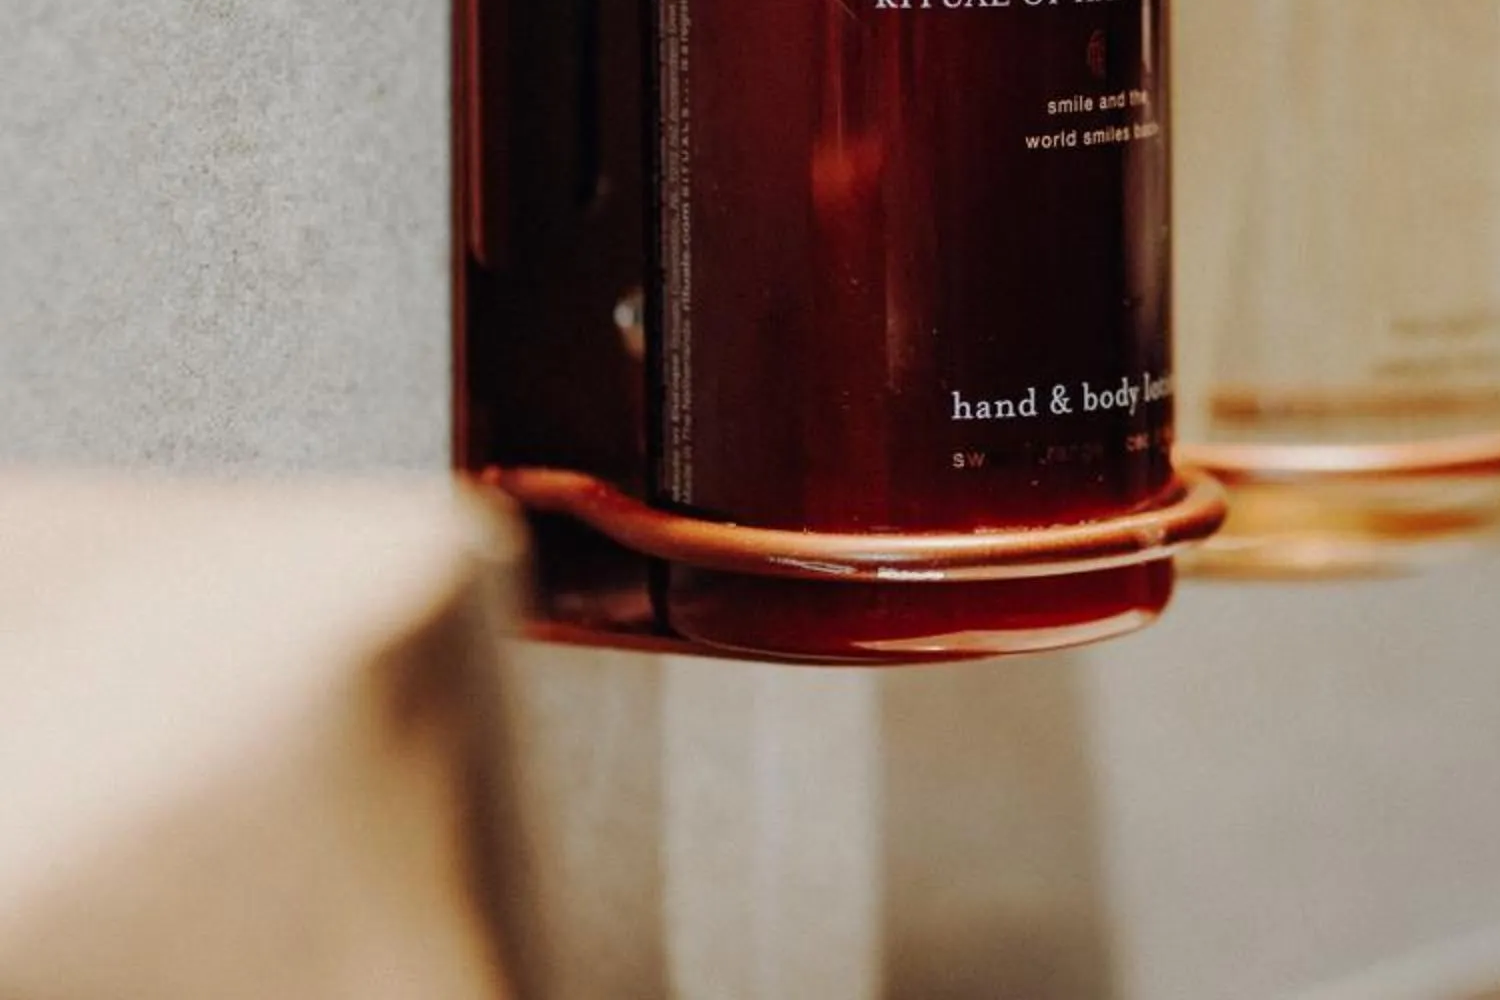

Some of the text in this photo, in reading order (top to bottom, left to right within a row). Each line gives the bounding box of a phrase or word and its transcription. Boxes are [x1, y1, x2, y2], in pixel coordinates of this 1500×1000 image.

[1047, 95, 1093, 115] smile
[1099, 91, 1126, 110] and
[1025, 130, 1077, 149] world
[1083, 126, 1131, 146] smiles
[951, 387, 1039, 421] hand
[1050, 384, 1073, 415] &
[1081, 376, 1141, 417] body
